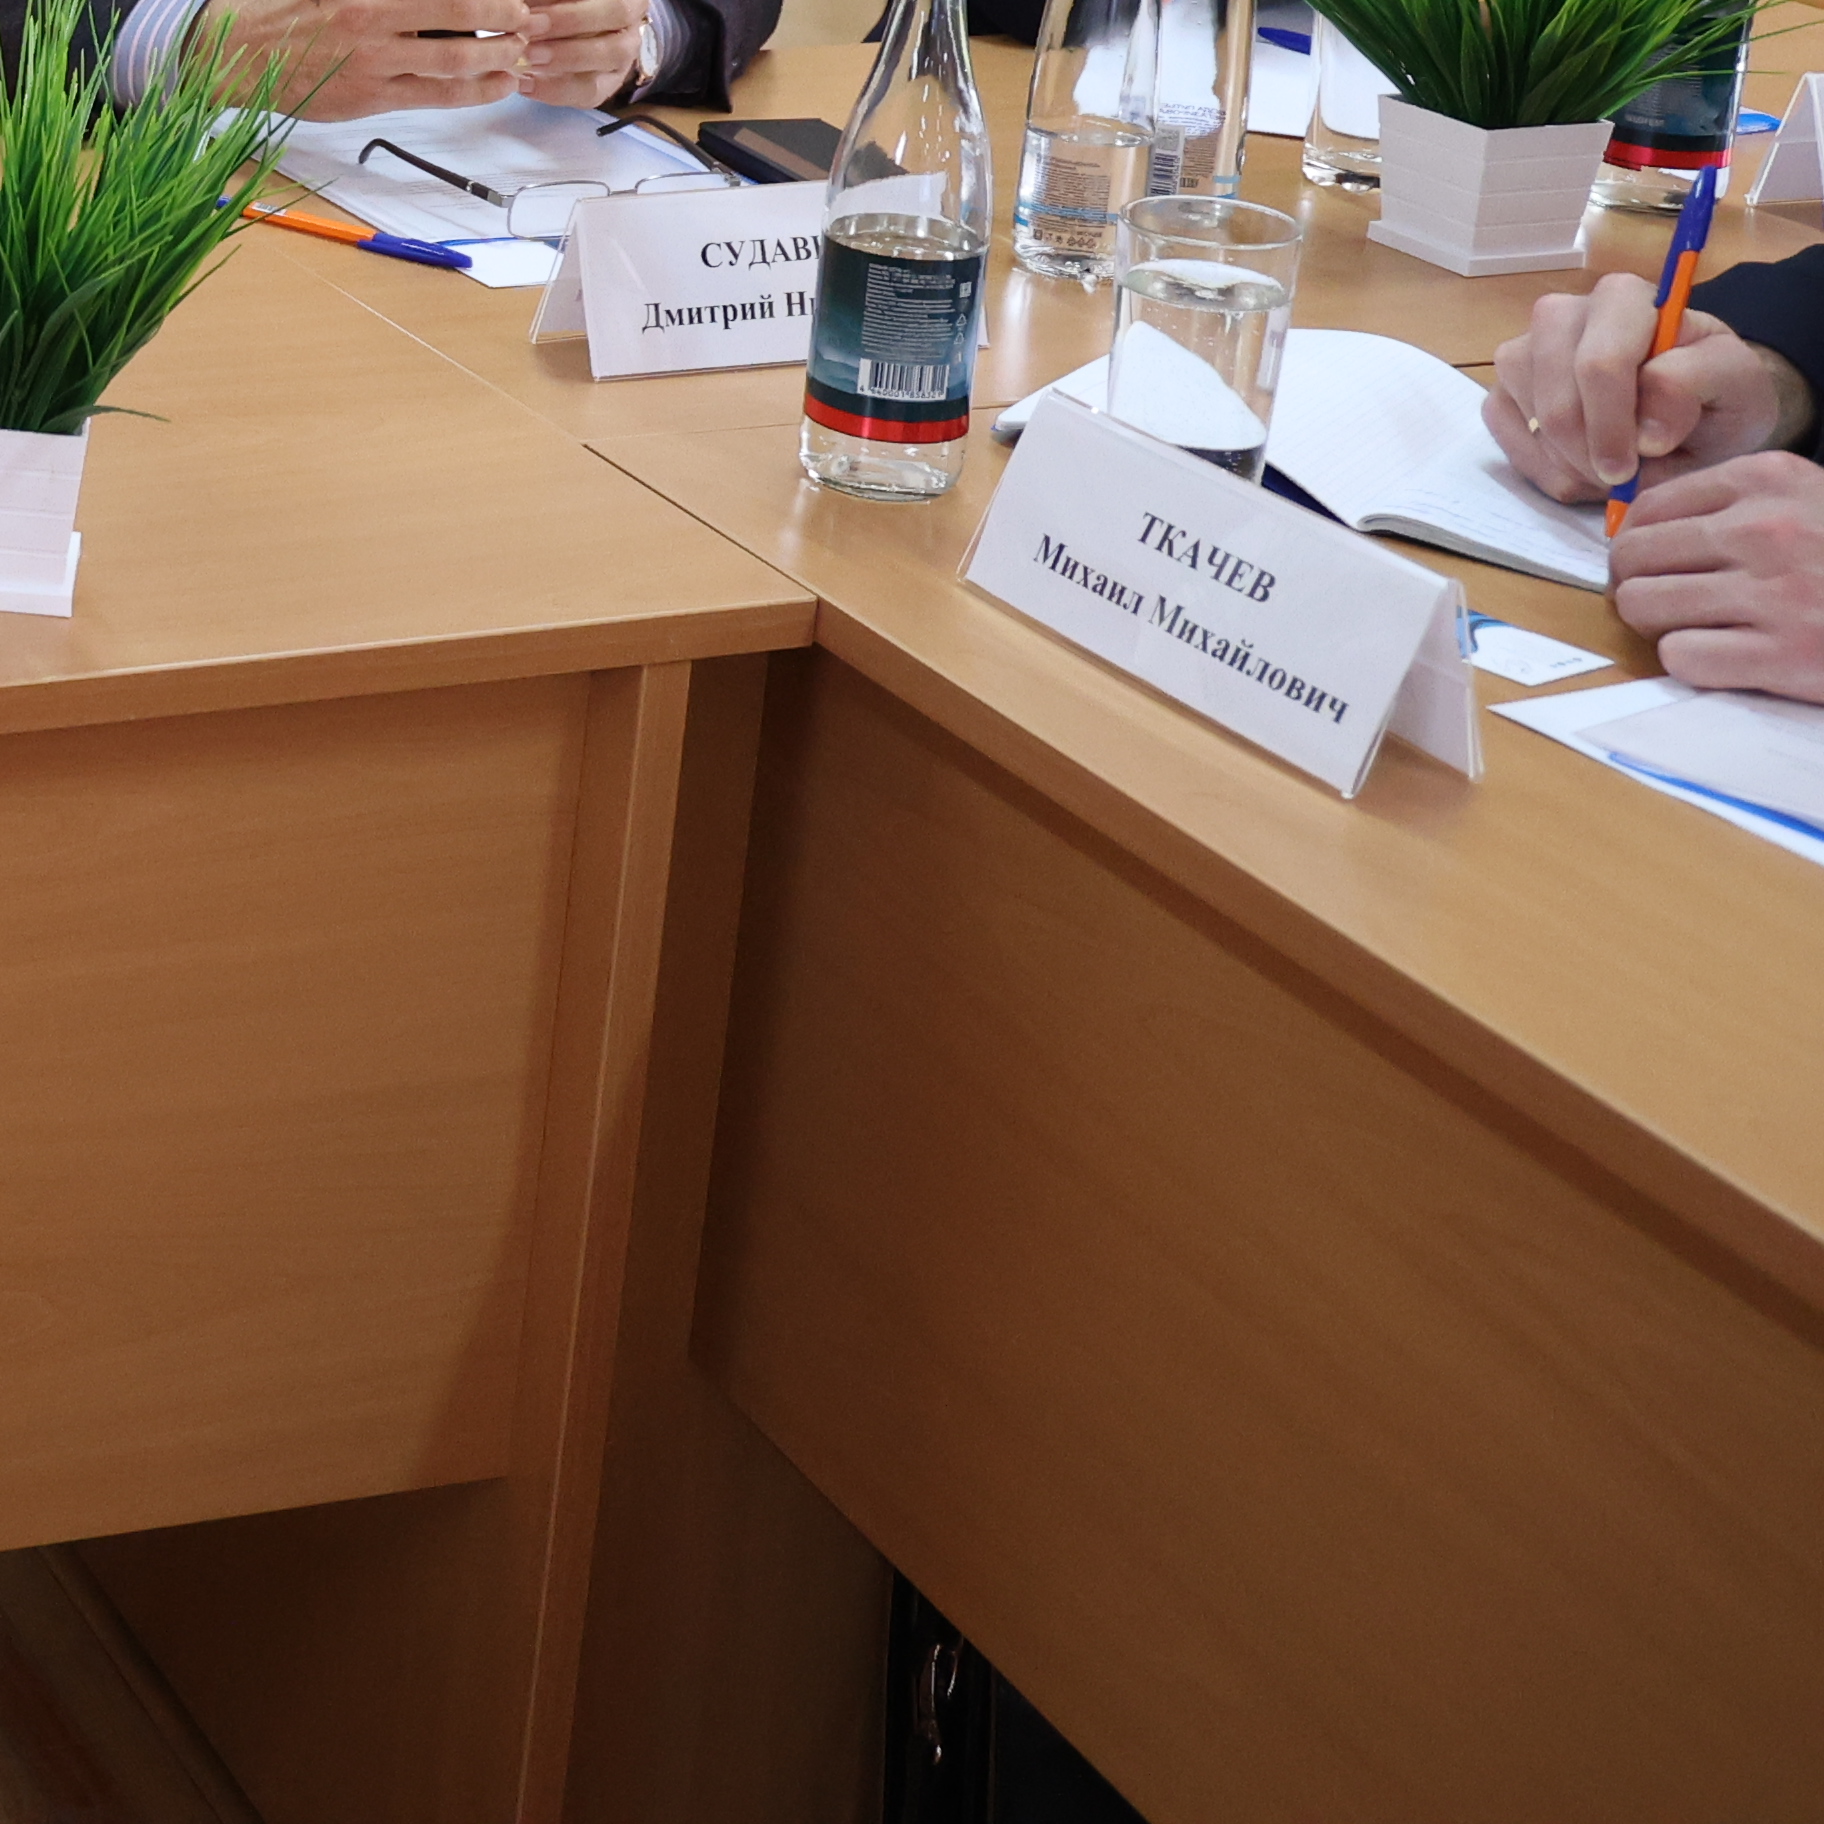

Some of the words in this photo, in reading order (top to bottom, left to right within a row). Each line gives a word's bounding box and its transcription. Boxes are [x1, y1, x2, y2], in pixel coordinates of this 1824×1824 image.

[642, 290, 775, 334] Дмитрий
[1137, 512, 1276, 605] ТКАЧЕВ
[1033, 533, 1145, 616] Михаил
[1148, 594, 1350, 725] Михайлович
